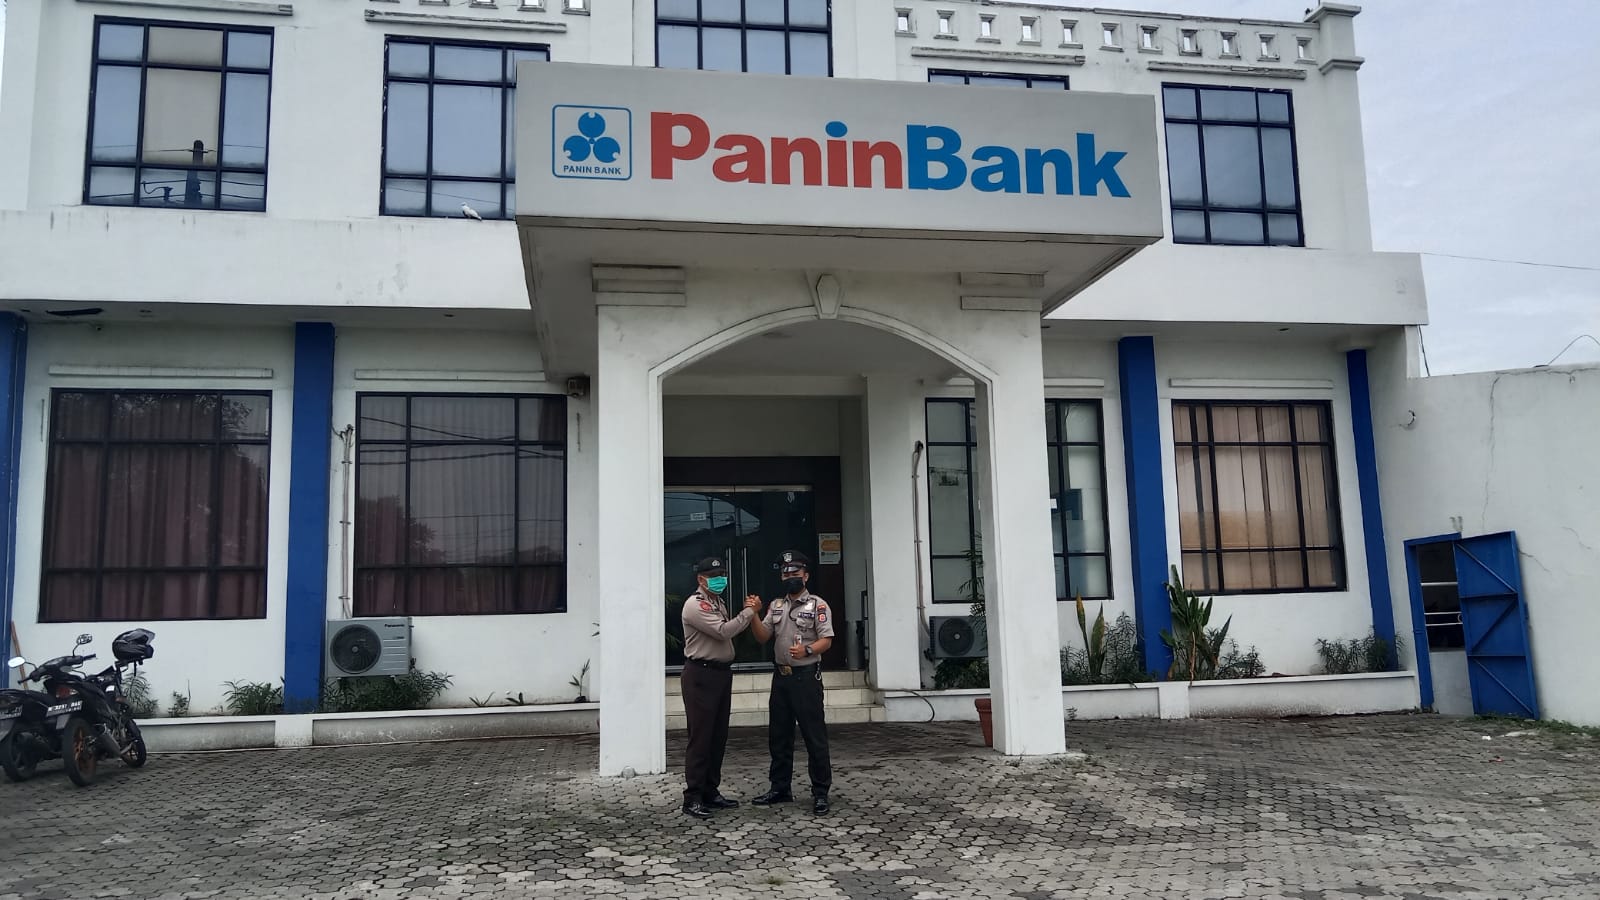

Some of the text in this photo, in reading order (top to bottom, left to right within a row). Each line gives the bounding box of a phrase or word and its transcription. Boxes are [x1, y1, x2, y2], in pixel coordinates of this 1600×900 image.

[563, 165, 621, 175] PANIN BANK
[650, 111, 1131, 198] PaninBank
